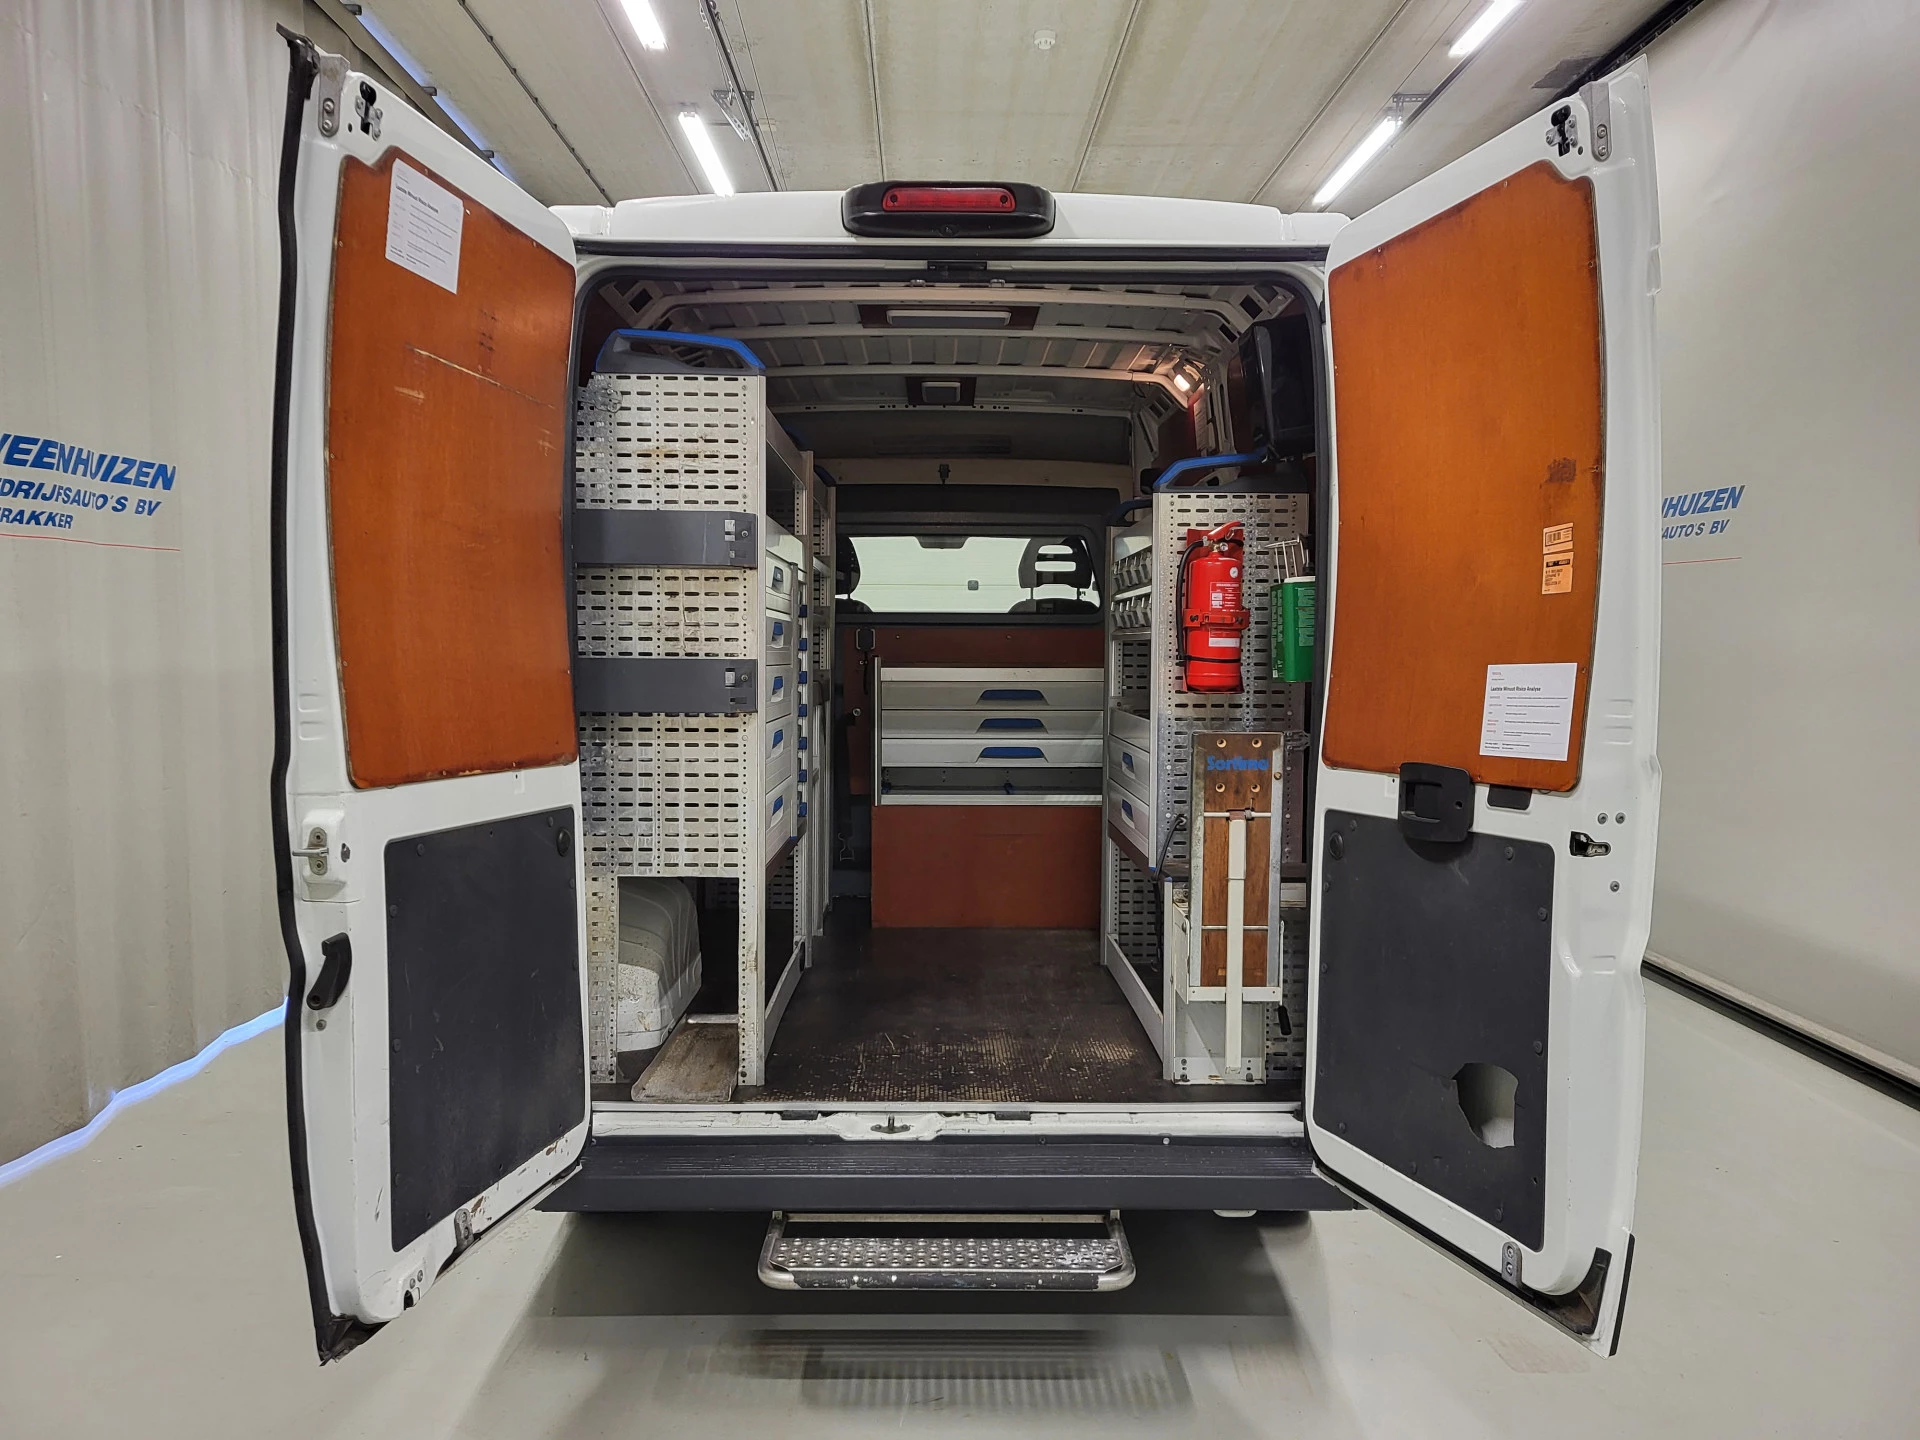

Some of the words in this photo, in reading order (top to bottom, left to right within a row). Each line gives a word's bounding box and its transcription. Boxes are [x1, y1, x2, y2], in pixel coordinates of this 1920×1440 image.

[0, 478, 129, 513] DRIJFSAUTO'S
[134, 499, 162, 516] BV
[0, 506, 74, 529] RAKKER
[1662, 522, 1705, 539] AUTO'S
[1709, 519, 1730, 535] BV
[1206, 755, 1269, 771] Sortimo
